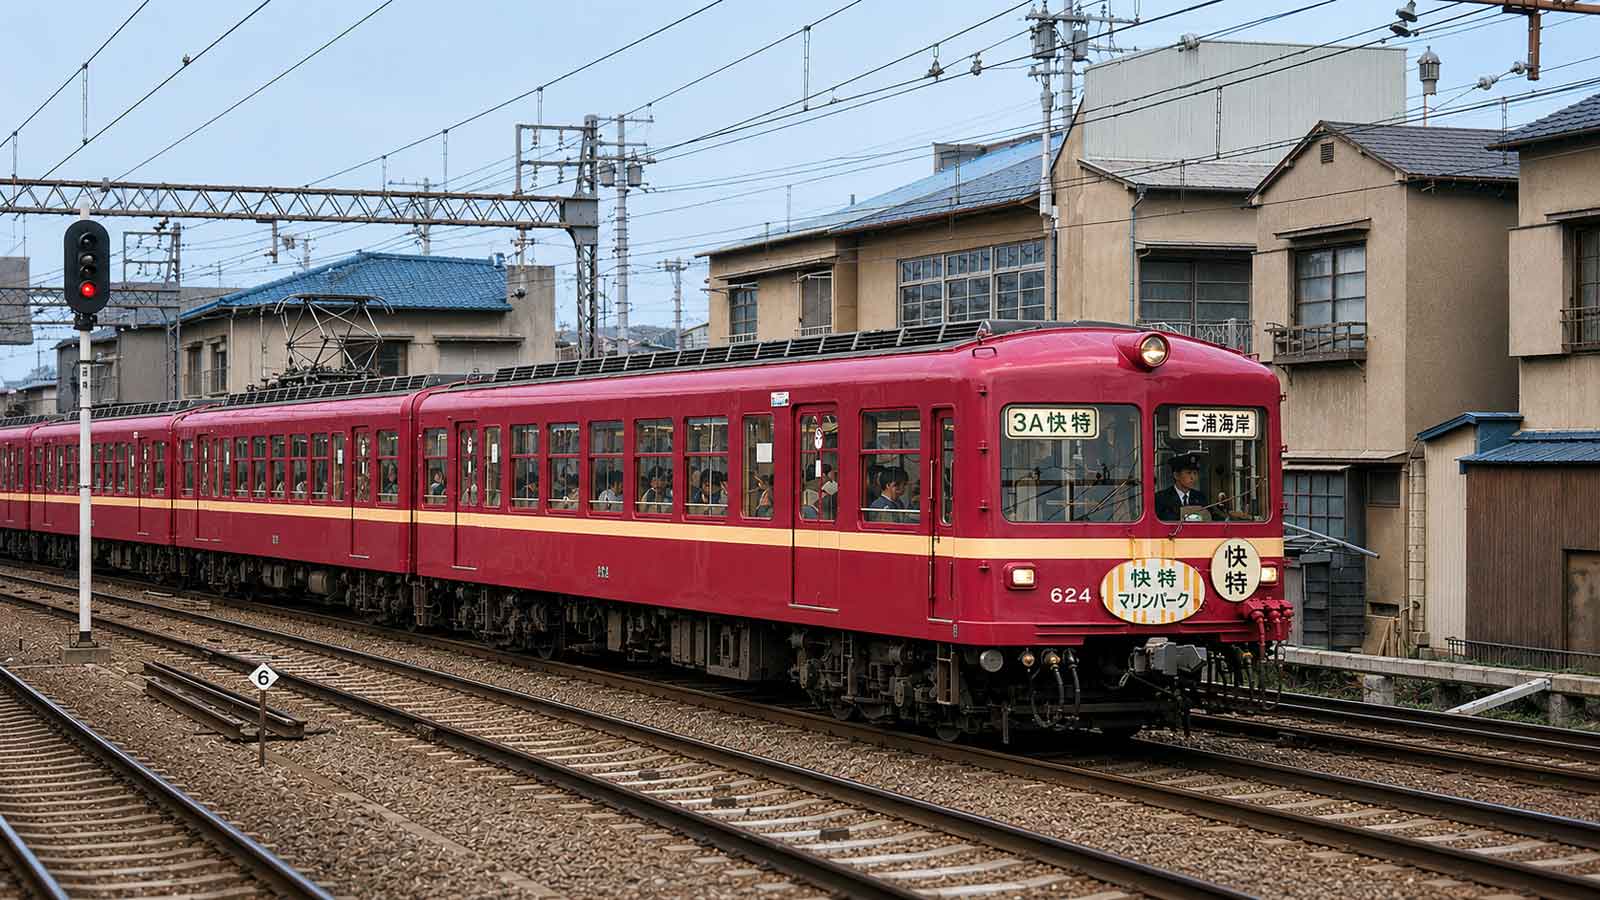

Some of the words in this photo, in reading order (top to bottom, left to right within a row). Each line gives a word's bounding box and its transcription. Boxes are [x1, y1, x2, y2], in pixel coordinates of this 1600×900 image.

[1013, 411, 1091, 433] 3A快特
[1184, 413, 1249, 433] 三浦海岸
[1131, 569, 1176, 588] 快特
[1225, 545, 1247, 595] 快特
[1051, 588, 1091, 603] 624
[1118, 592, 1189, 608] マリンパーク
[258, 670, 269, 685] 6
